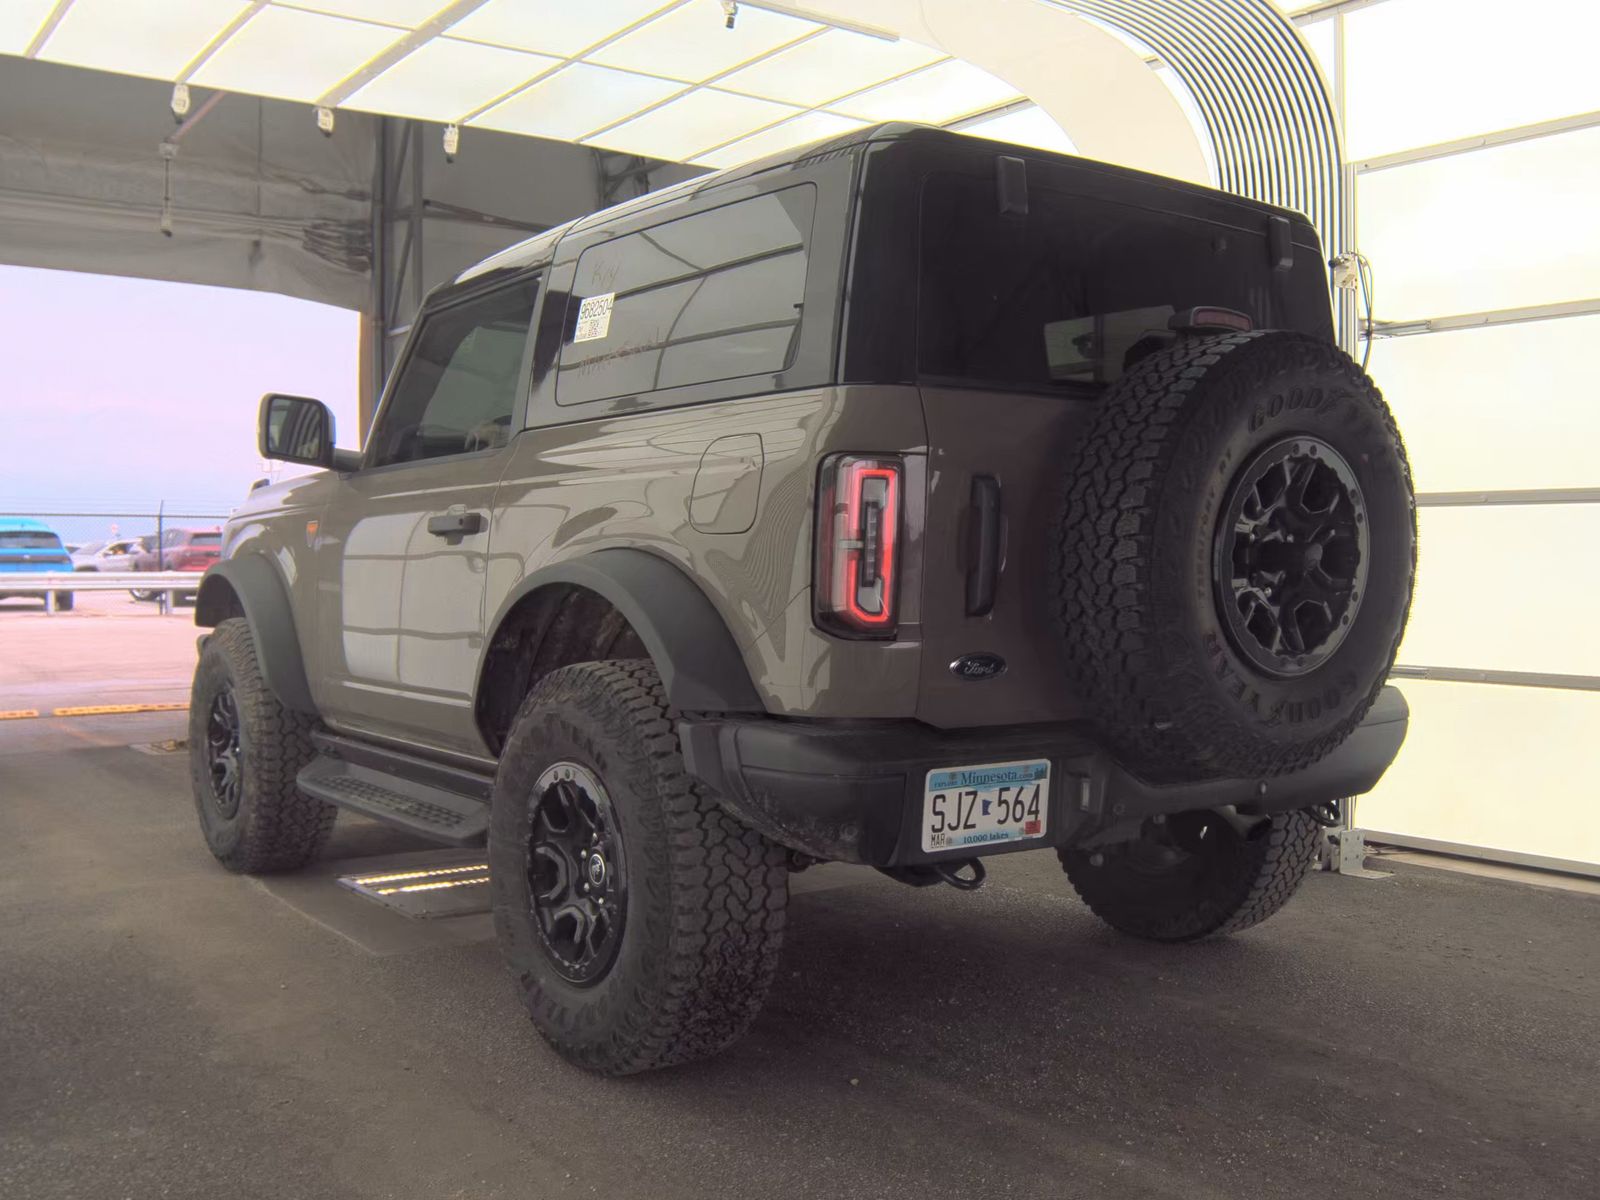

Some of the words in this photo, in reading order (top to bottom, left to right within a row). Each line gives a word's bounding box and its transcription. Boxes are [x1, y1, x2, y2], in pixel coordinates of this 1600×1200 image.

[580, 297, 613, 320] 9682504
[964, 661, 994, 674] Ford
[931, 790, 978, 833] SJZ
[997, 784, 1040, 825] 564
[931, 833, 945, 846] MAR
[963, 834, 988, 844] 10,000
[989, 832, 1009, 840] lakes
